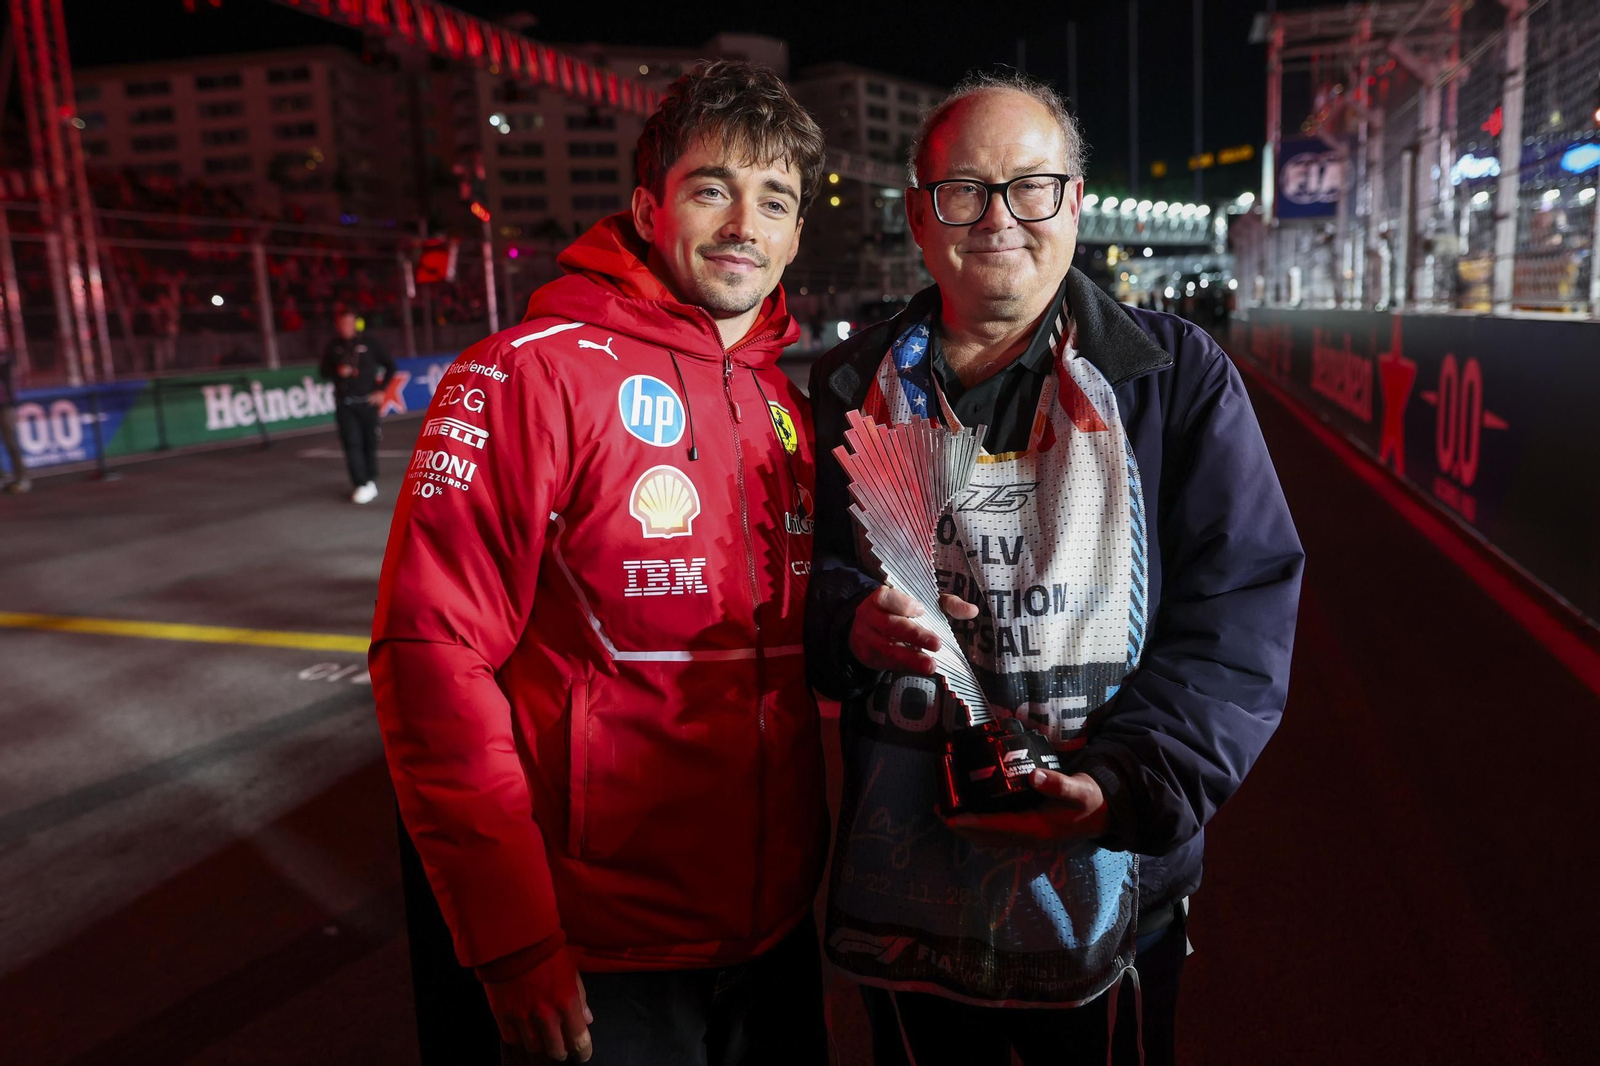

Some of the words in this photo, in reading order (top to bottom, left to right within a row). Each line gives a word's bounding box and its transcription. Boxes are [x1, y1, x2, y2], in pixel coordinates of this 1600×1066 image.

[448, 360, 509, 383] Bitdefender
[438, 384, 486, 414] ZCG
[631, 377, 676, 443] hp
[422, 417, 490, 450] PIRELLI
[411, 449, 477, 482] PERONI
[412, 481, 443, 499] 0.0%
[423, 472, 469, 492] AZZURRO
[622, 557, 708, 597] IBM
